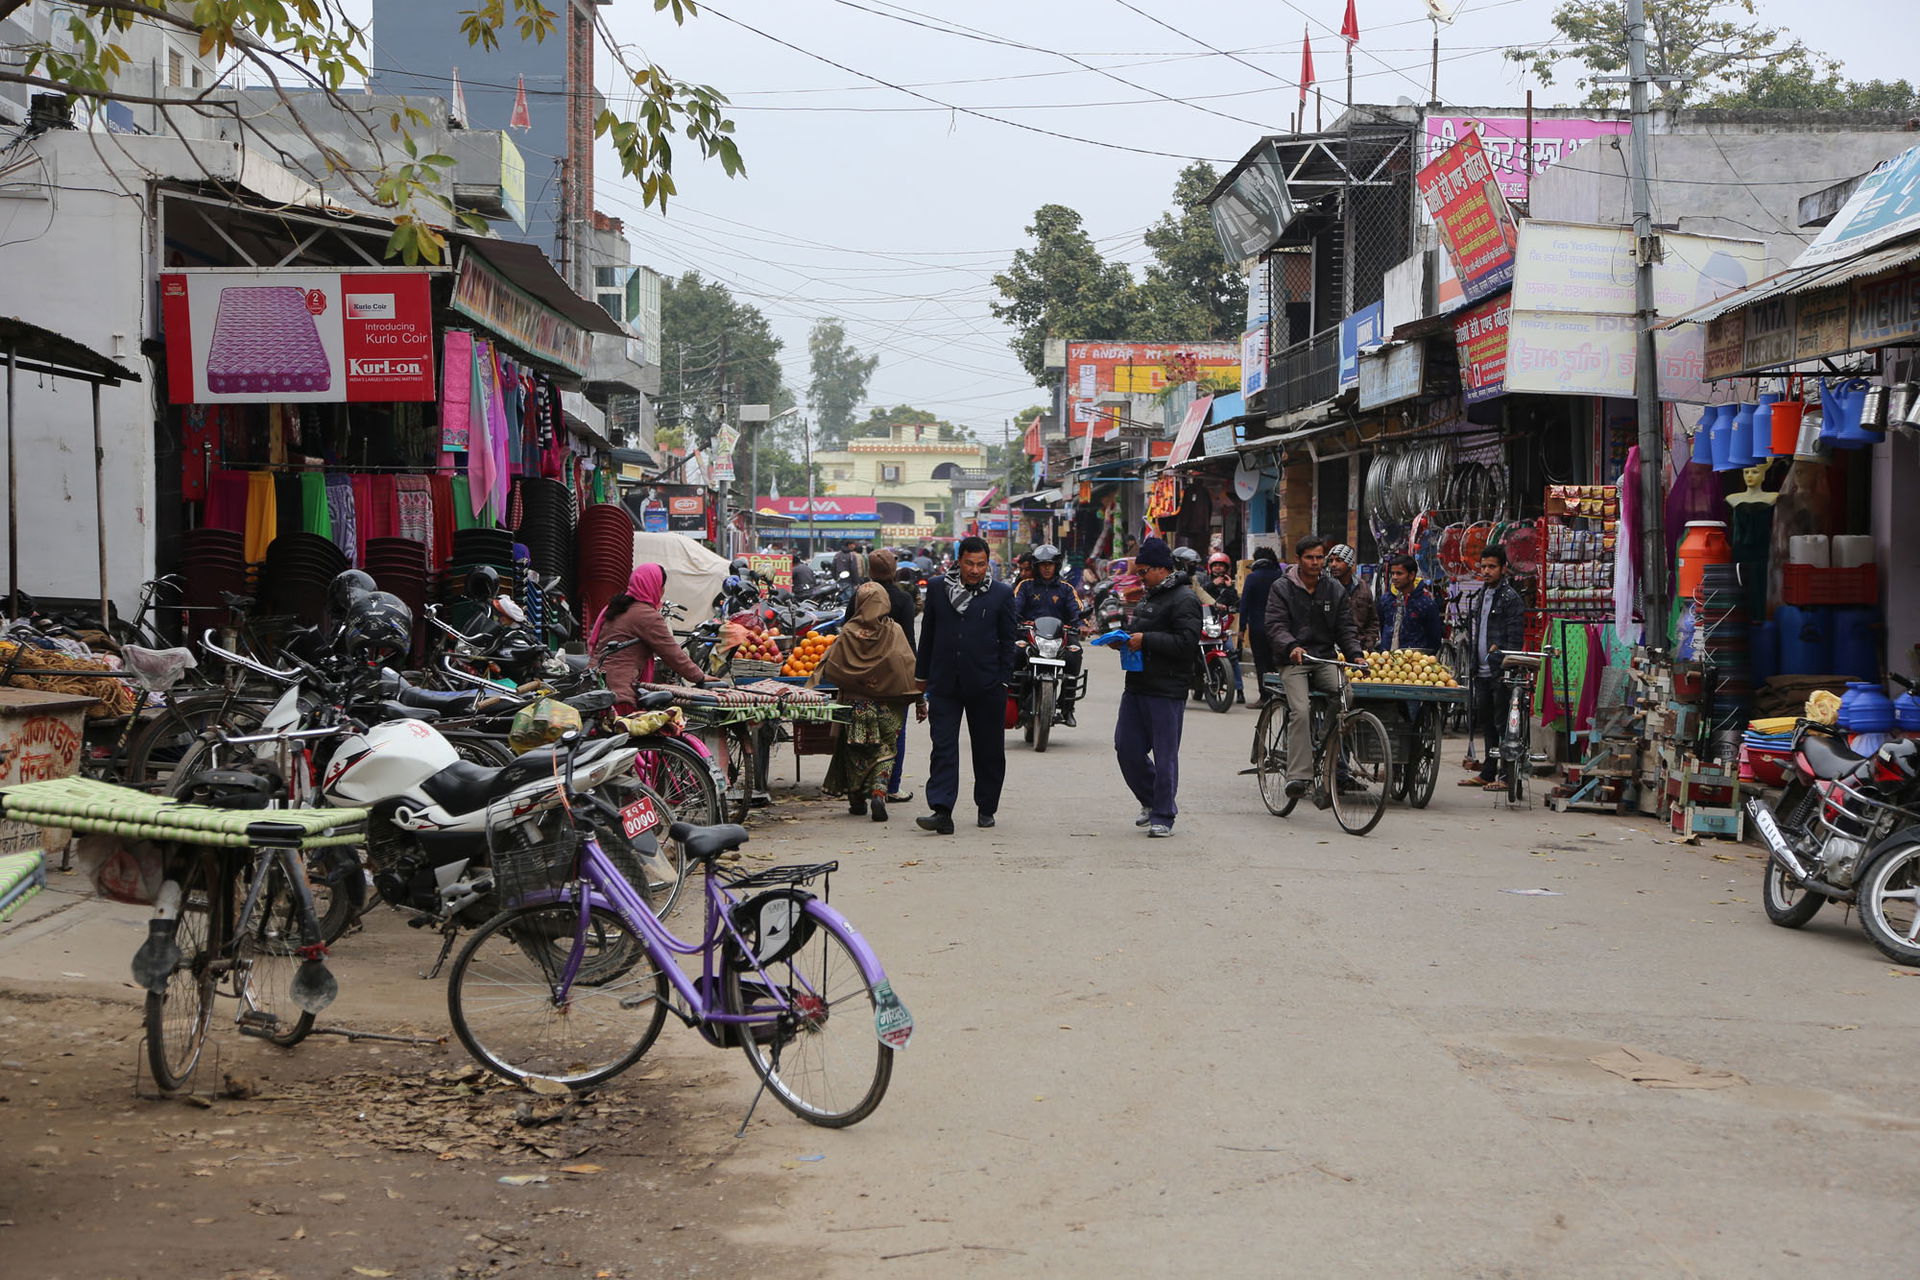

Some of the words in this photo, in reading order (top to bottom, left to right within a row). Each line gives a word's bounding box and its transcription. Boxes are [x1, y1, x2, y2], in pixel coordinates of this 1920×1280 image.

[312, 292, 319, 303] 2
[1753, 302, 1787, 335] TATA
[365, 323, 415, 332] Introducing
[366, 333, 397, 344] Kurlo
[402, 333, 427, 343] Coir
[1092, 349, 1134, 361] ANDAR
[1747, 333, 1792, 367] AGRICO
[349, 358, 422, 376] Kurl-on
[788, 500, 842, 512] LAVA
